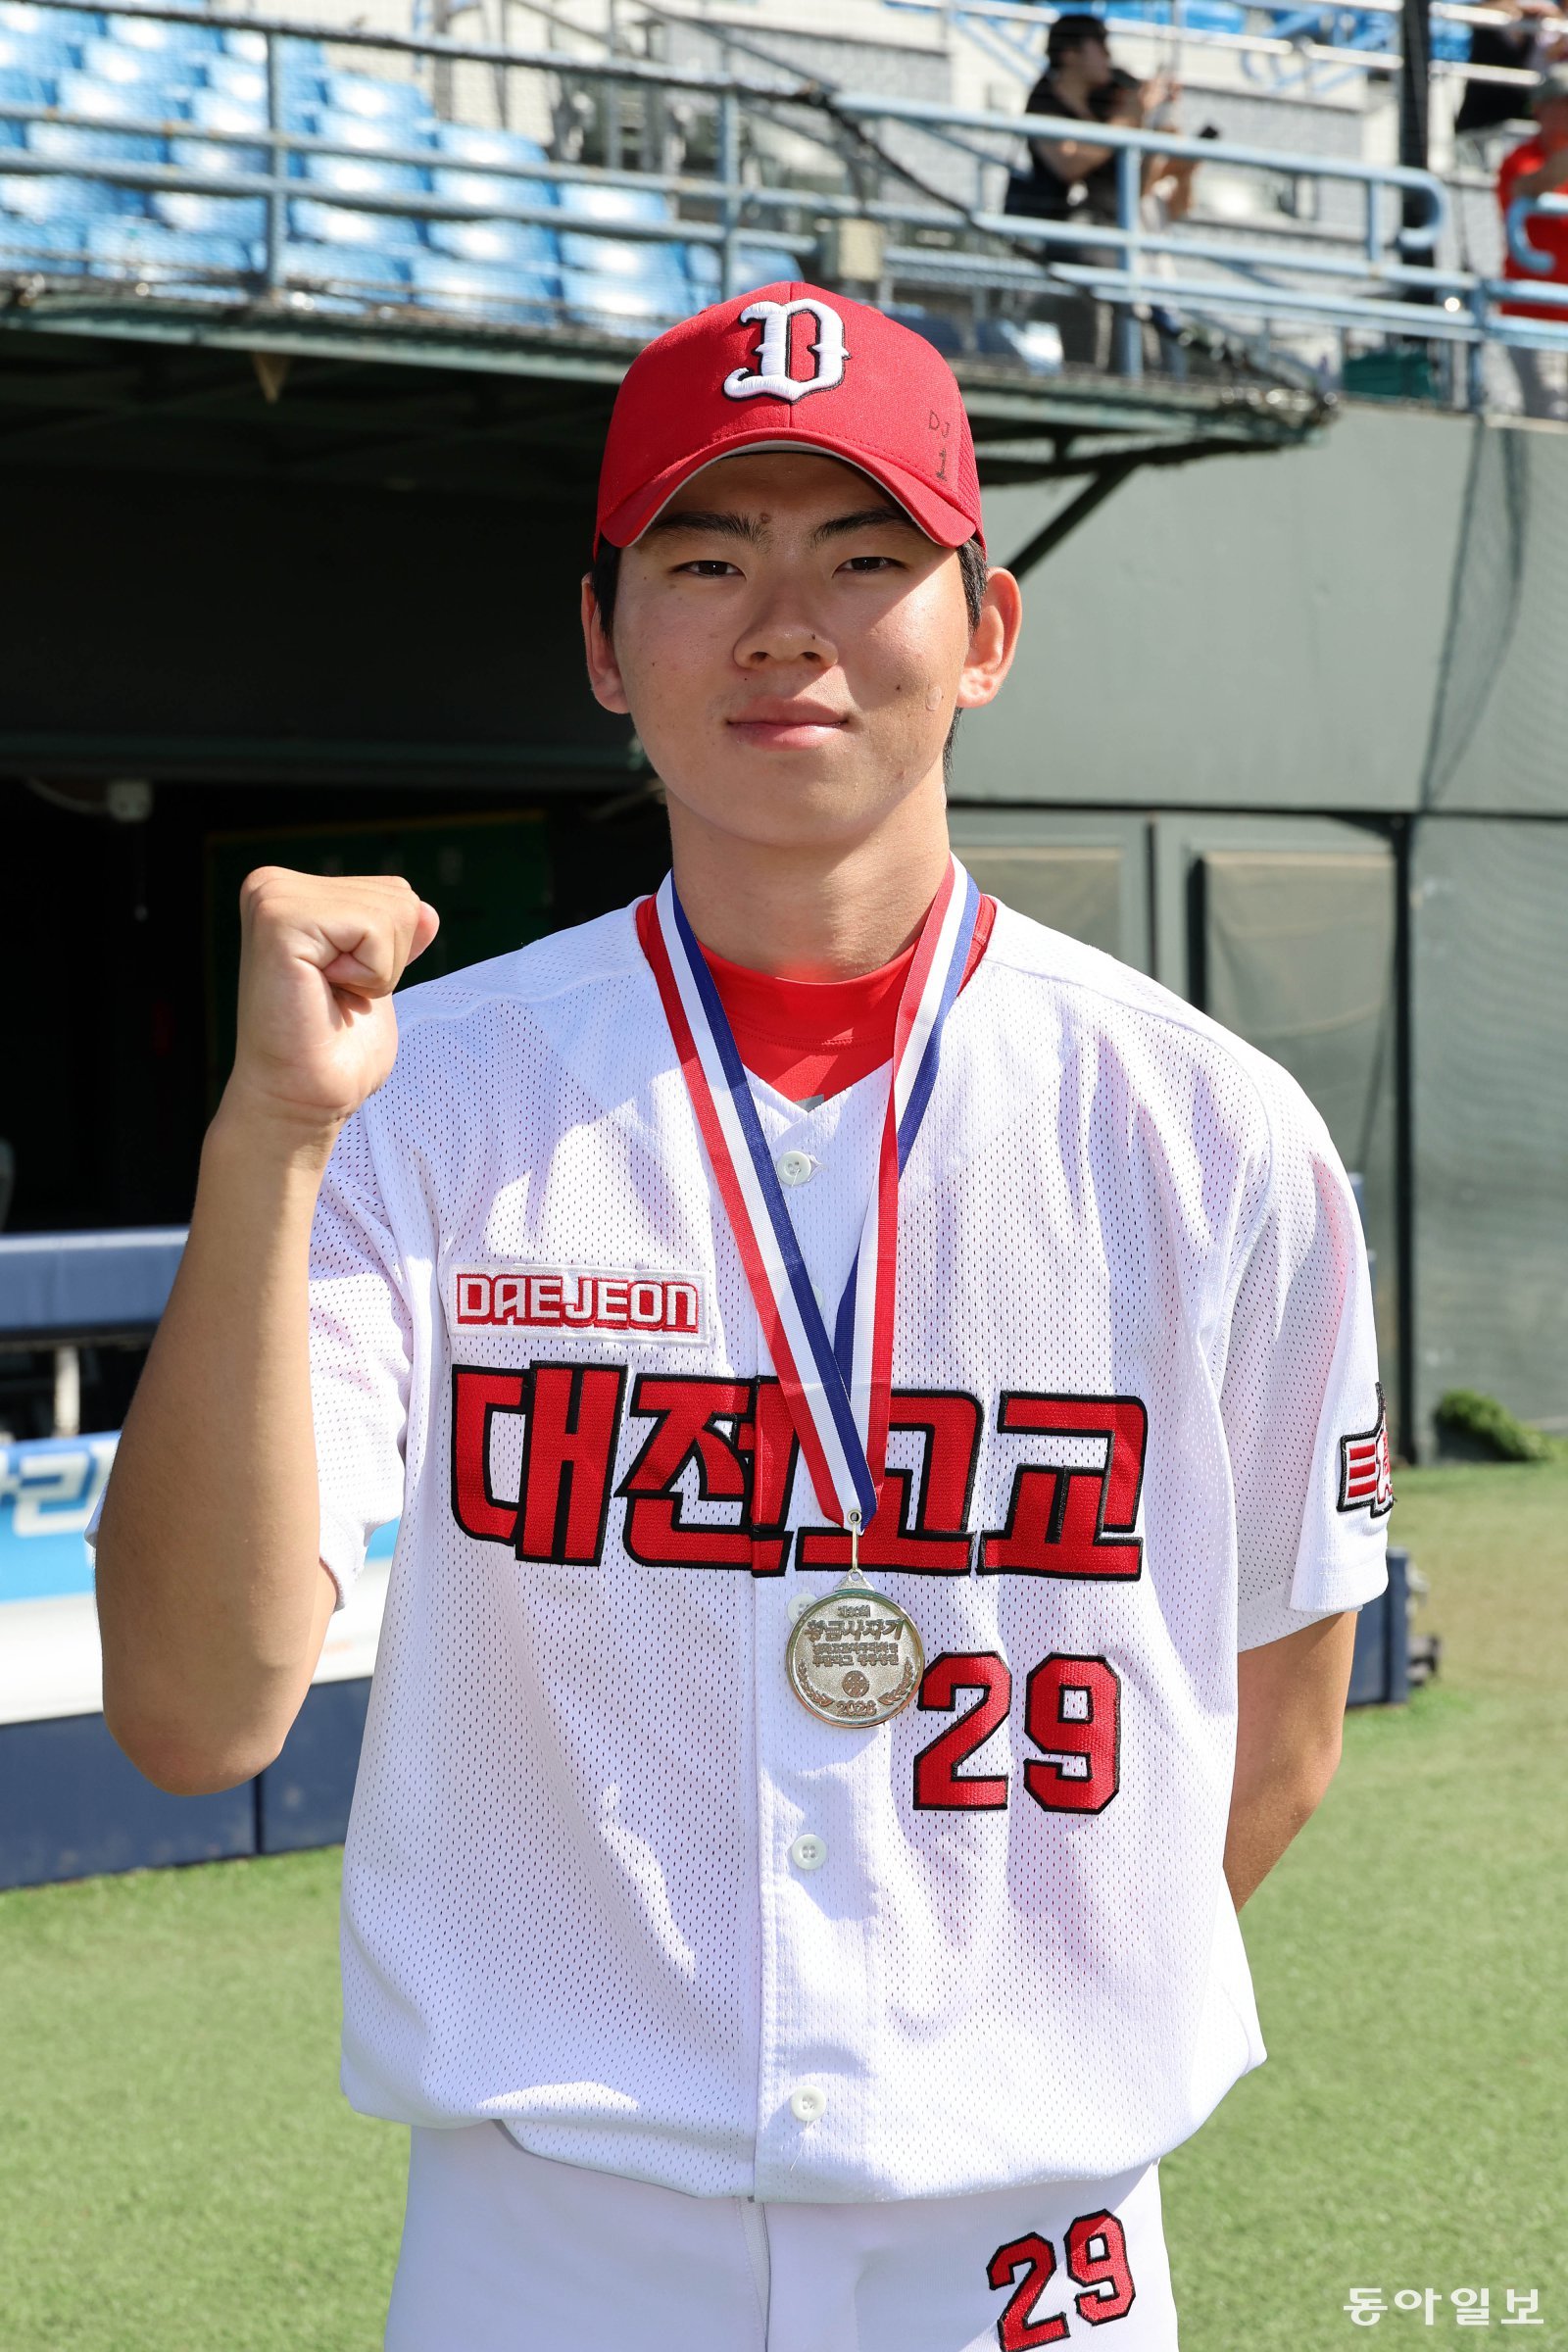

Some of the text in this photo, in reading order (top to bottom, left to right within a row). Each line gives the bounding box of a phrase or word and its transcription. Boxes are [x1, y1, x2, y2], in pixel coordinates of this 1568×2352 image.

[723, 298, 852, 405] D
[458, 1274, 700, 1333] DAEJEON
[912, 1650, 1122, 1815] 29
[986, 2208, 1137, 2352] 29
